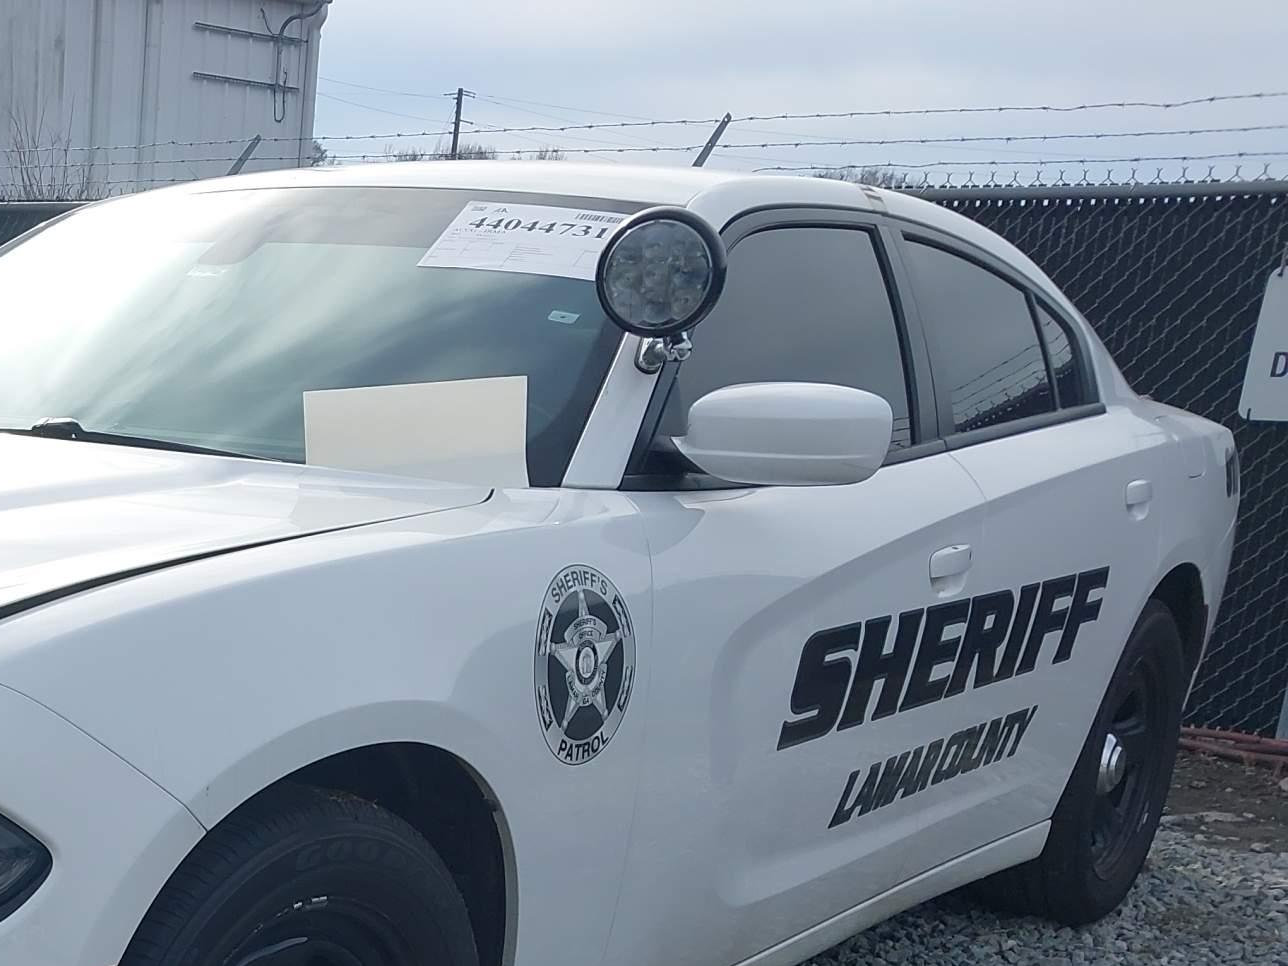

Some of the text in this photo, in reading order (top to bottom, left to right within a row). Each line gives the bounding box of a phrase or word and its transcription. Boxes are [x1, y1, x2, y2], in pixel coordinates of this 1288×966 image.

[469, 216, 609, 239] 44044731
[552, 570, 608, 604] SHERIFF'S
[776, 566, 1111, 751] SHERIFF
[557, 731, 609, 762] PATROL
[828, 705, 1039, 829] LAMAR COUNTY
